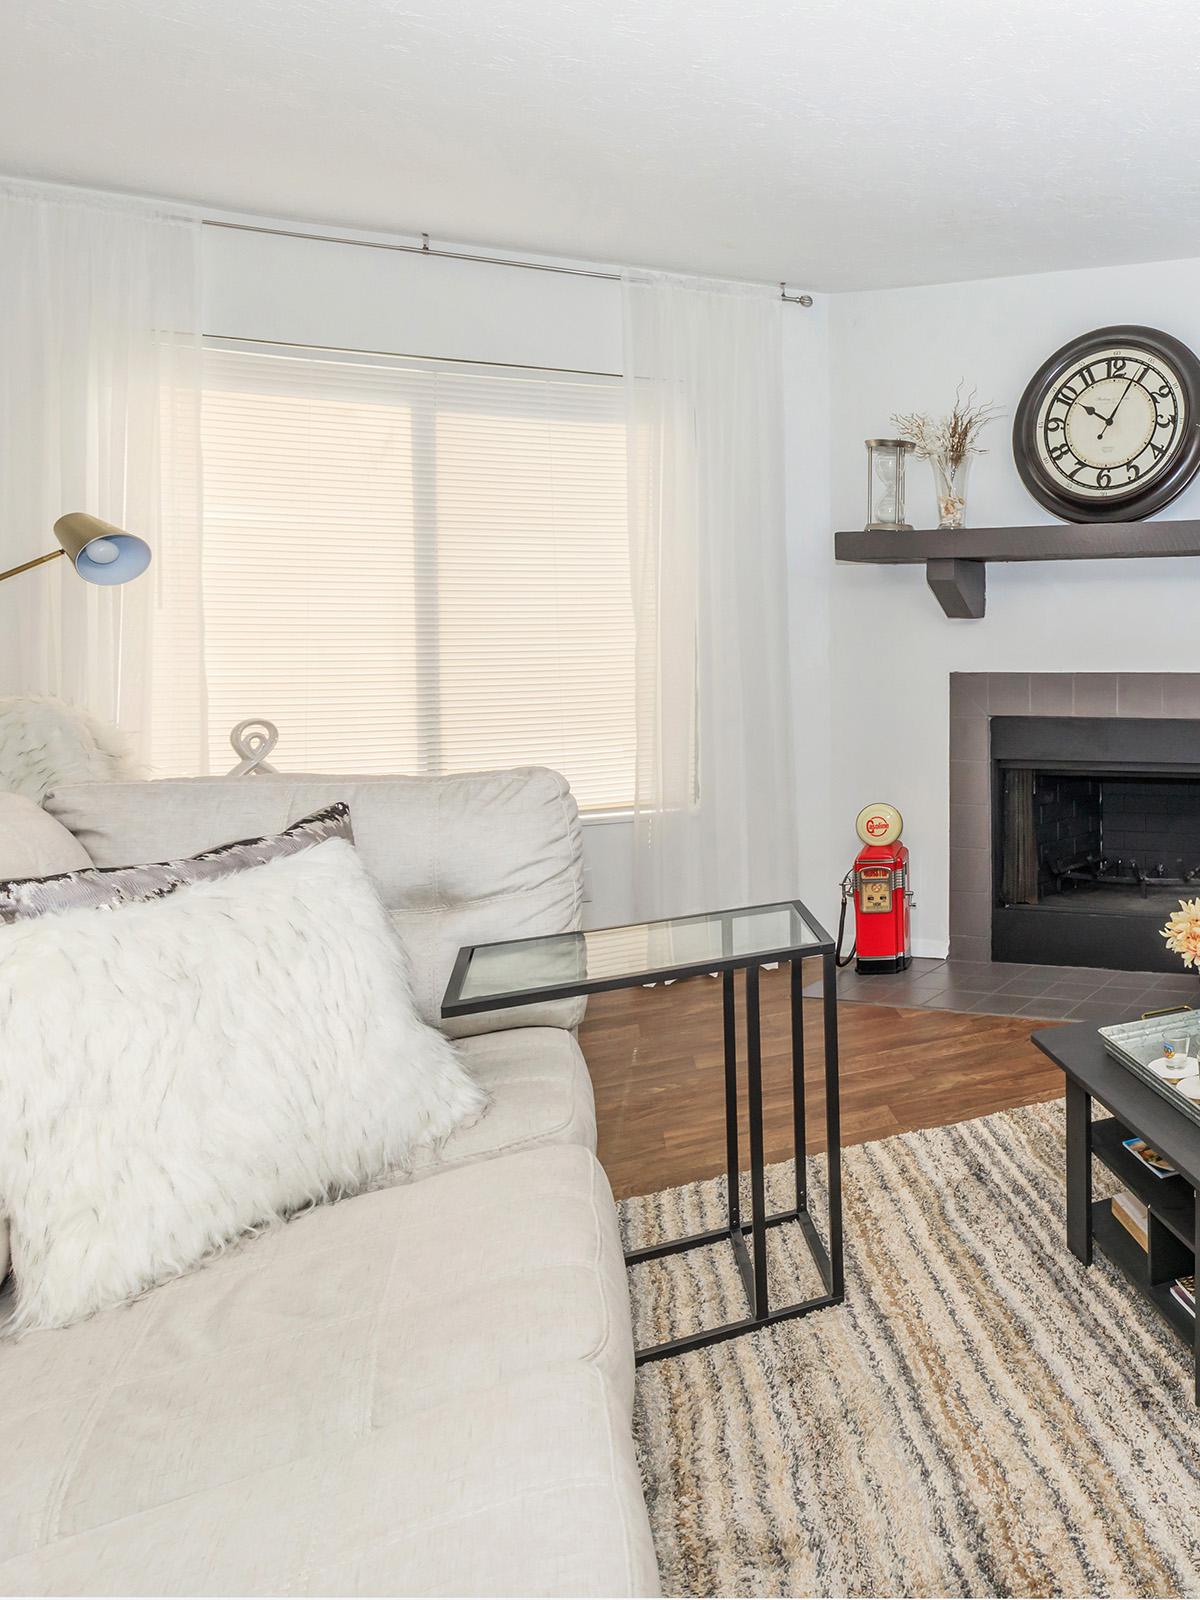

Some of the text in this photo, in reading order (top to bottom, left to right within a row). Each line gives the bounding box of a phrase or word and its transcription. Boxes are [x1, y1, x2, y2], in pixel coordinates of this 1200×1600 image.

[1078, 367, 1096, 387] 11
[1105, 359, 1127, 378] 12
[1136, 365, 1150, 383] 1
[1055, 385, 1078, 406] 10
[1150, 385, 1171, 404] 2
[1047, 417, 1064, 432] 9
[1157, 414, 1175, 429] 3
[1050, 443, 1069, 461] 8
[1150, 443, 1166, 460] 4
[1068, 461, 1088, 479] 7
[1096, 469, 1111, 488] 6
[1126, 463, 1141, 482] 5
[866, 820, 889, 833] Gasoline
